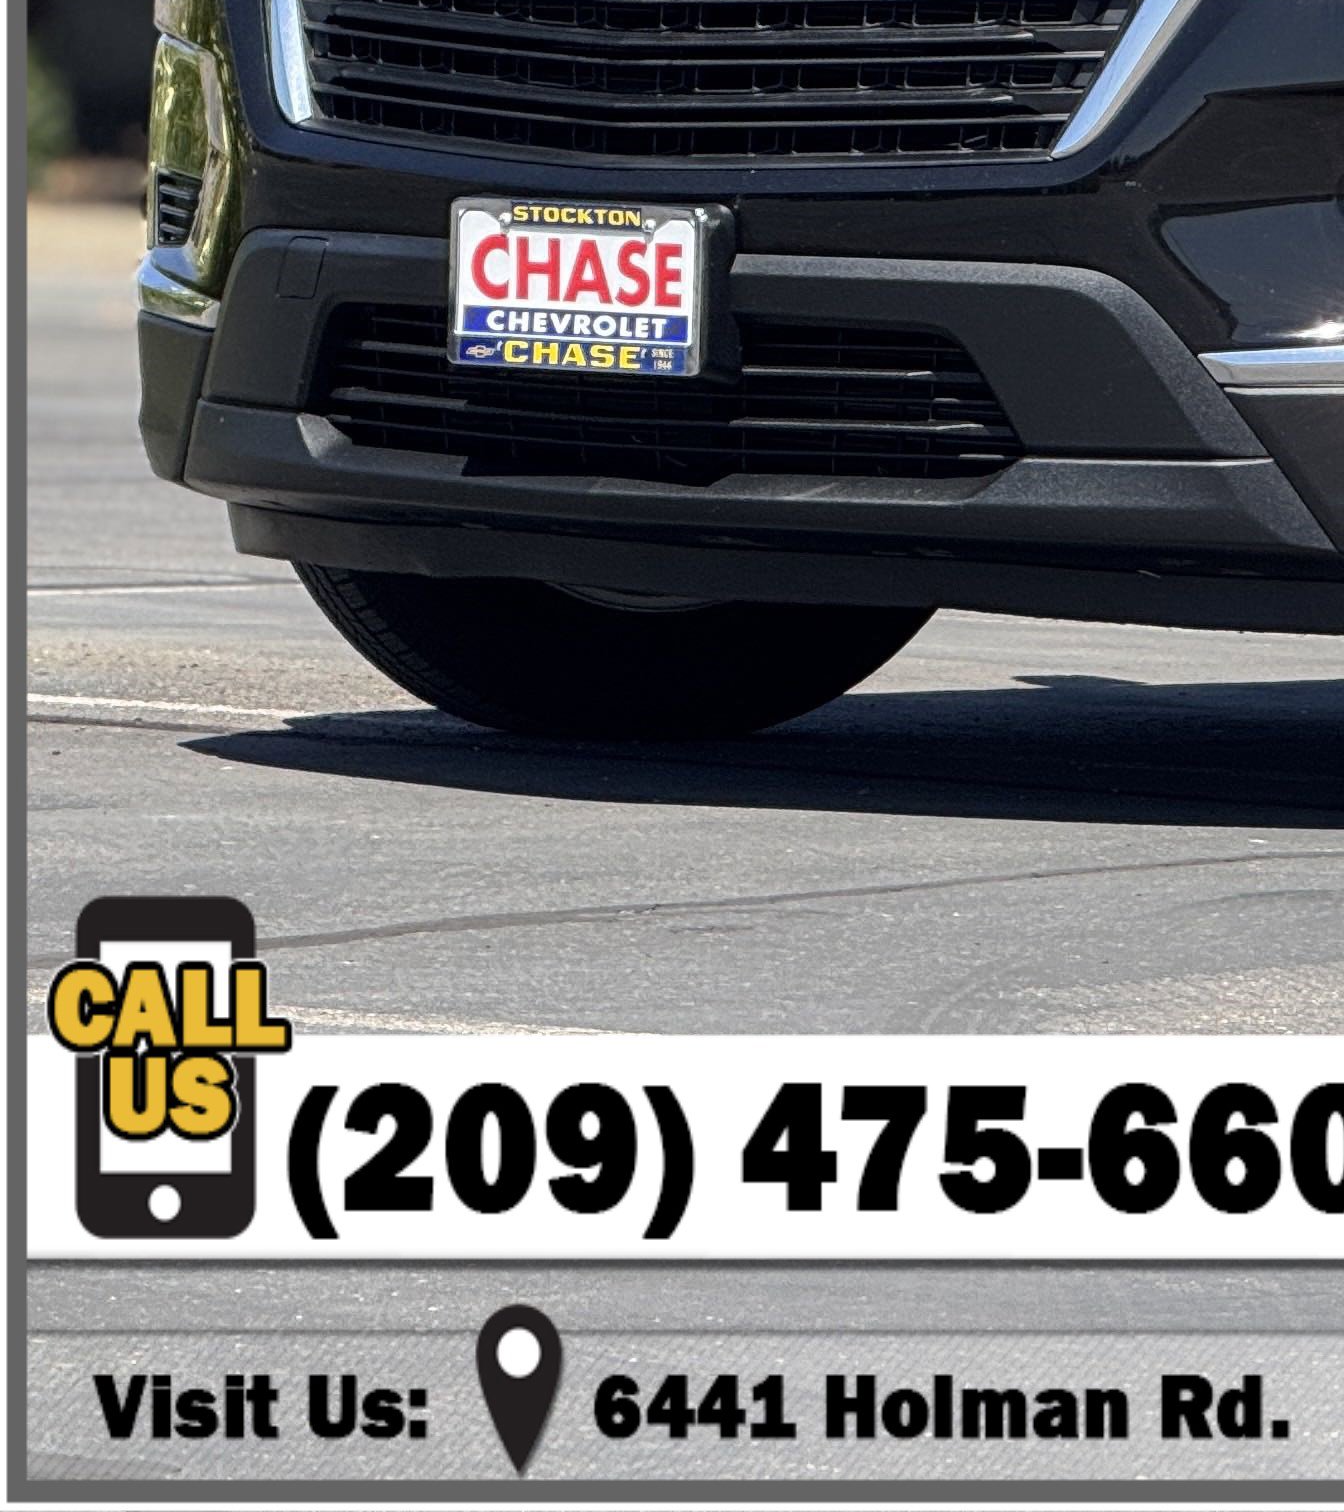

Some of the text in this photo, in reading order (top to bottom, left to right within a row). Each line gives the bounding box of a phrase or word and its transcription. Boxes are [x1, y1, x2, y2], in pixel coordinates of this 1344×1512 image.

[512, 205, 641, 227] STOCKTON
[471, 233, 683, 308] CHASE
[486, 310, 668, 339] CHEVROLET
